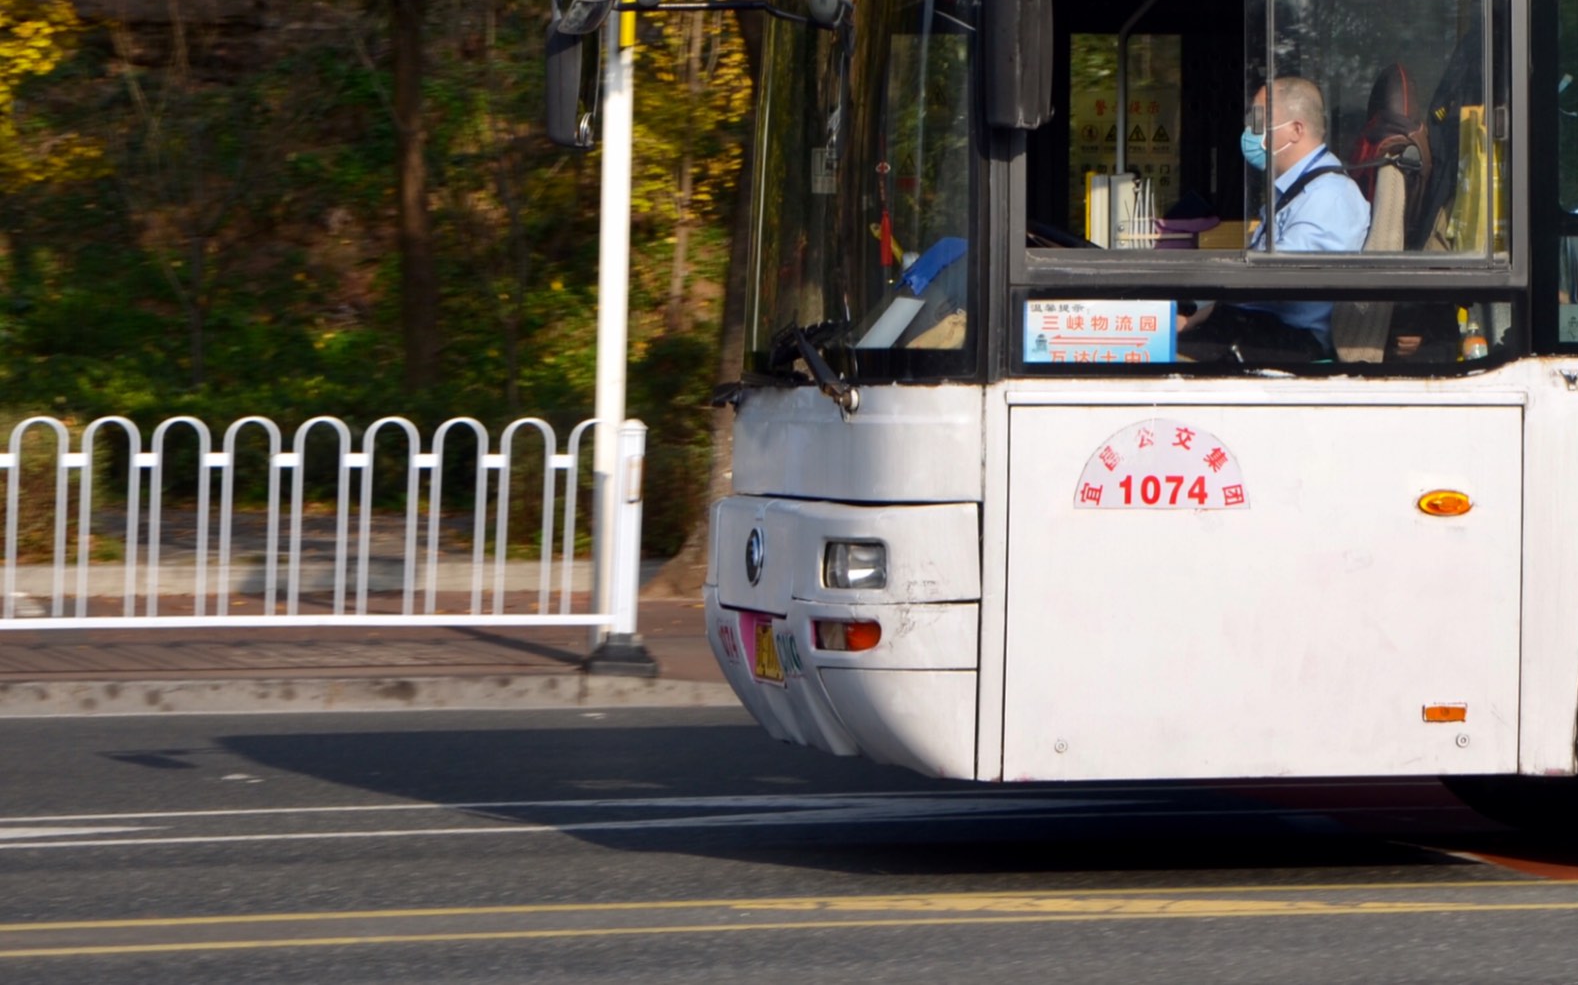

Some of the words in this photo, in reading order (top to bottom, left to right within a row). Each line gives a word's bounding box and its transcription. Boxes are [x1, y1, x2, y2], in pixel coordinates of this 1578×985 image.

[1042, 315, 1157, 331] 三峡物流园
[1119, 475, 1208, 505] 1074
